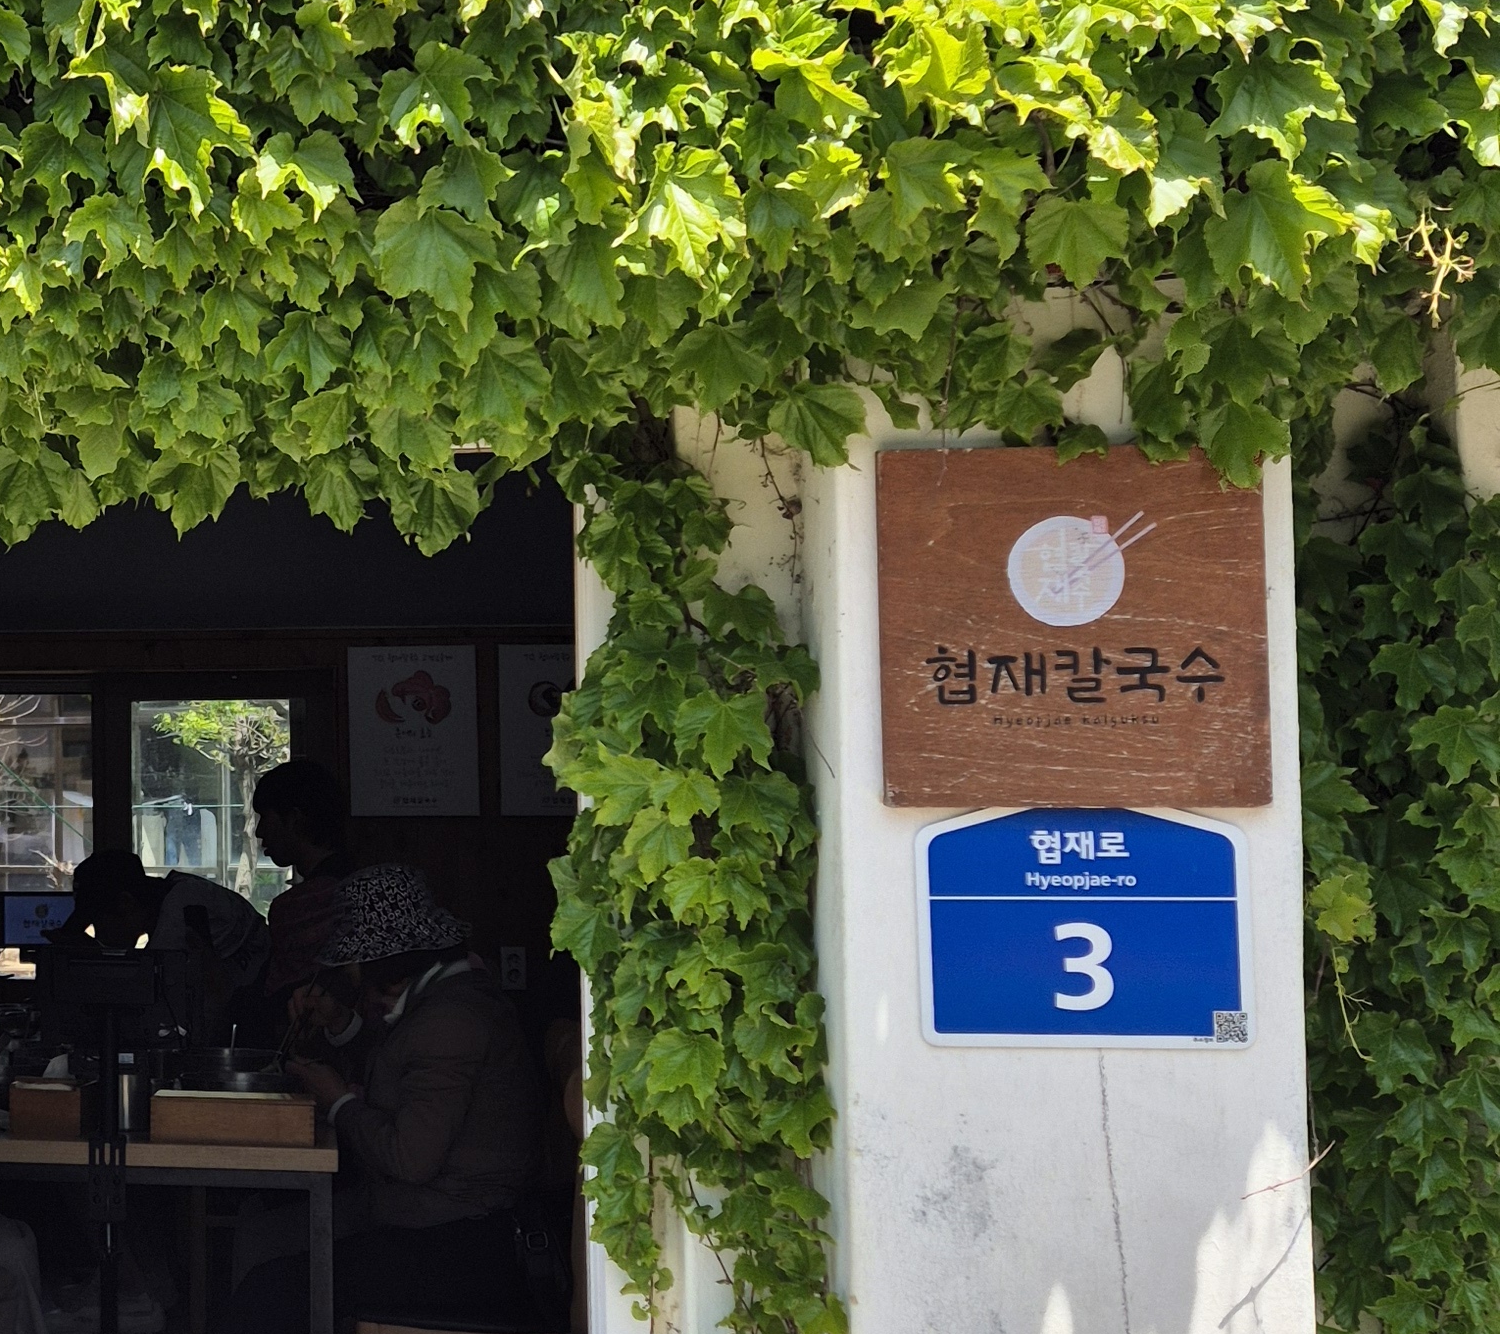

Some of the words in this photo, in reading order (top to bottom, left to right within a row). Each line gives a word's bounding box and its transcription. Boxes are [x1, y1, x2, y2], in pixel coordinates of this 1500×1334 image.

[925, 645, 1225, 705] 협재칼국수
[1029, 830, 1130, 864] 협재로
[1025, 872, 1137, 890] Hyeopjae-ro
[1054, 922, 1115, 1011] 3
